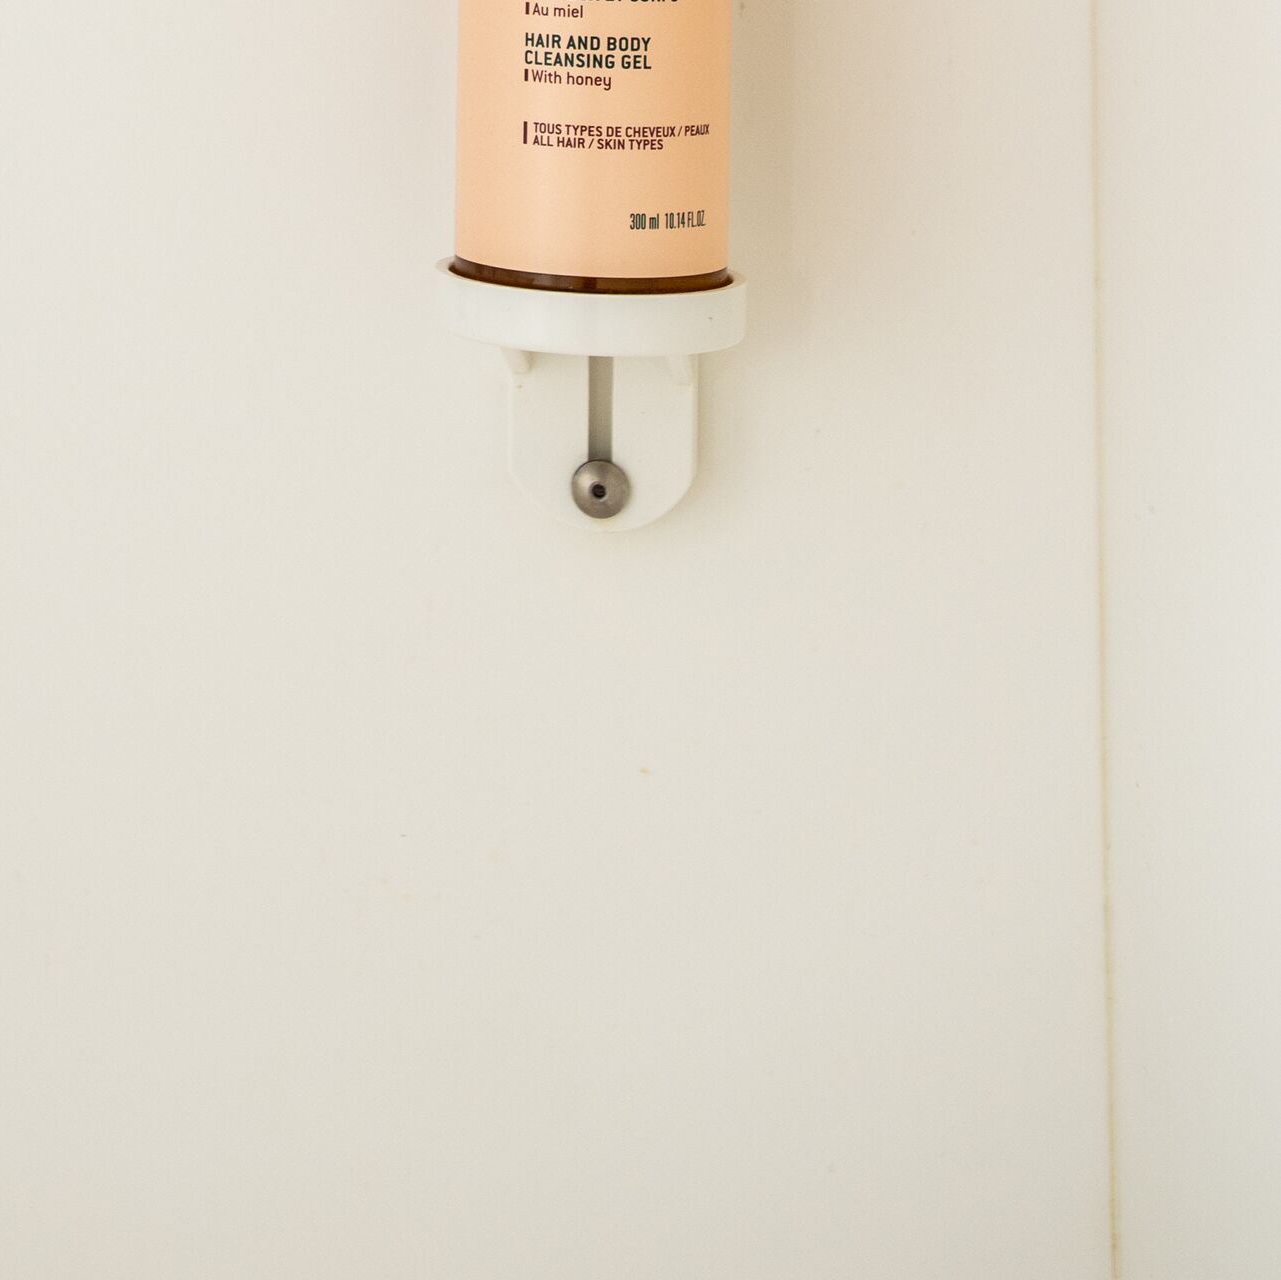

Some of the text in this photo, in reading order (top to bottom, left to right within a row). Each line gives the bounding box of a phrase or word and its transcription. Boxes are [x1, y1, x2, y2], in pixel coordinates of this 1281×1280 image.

[532, 3, 584, 18] Au miel
[525, 33, 651, 52] HAIR AND BODY
[524, 50, 652, 70] CLEANSING GEL
[531, 69, 612, 91] With honey
[533, 122, 562, 135] TOUS
[565, 124, 603, 137] TYPES
[606, 126, 622, 138] DE
[625, 126, 676, 138] CHEVEUX
[684, 124, 710, 136] PEAUX
[532, 136, 553, 147] ALL
[556, 137, 585, 149] HAIR
[596, 138, 626, 150] SKIN
[628, 139, 664, 150] TYPES
[629, 213, 646, 230] 300
[649, 213, 659, 229] ml
[665, 211, 686, 229] 10.14
